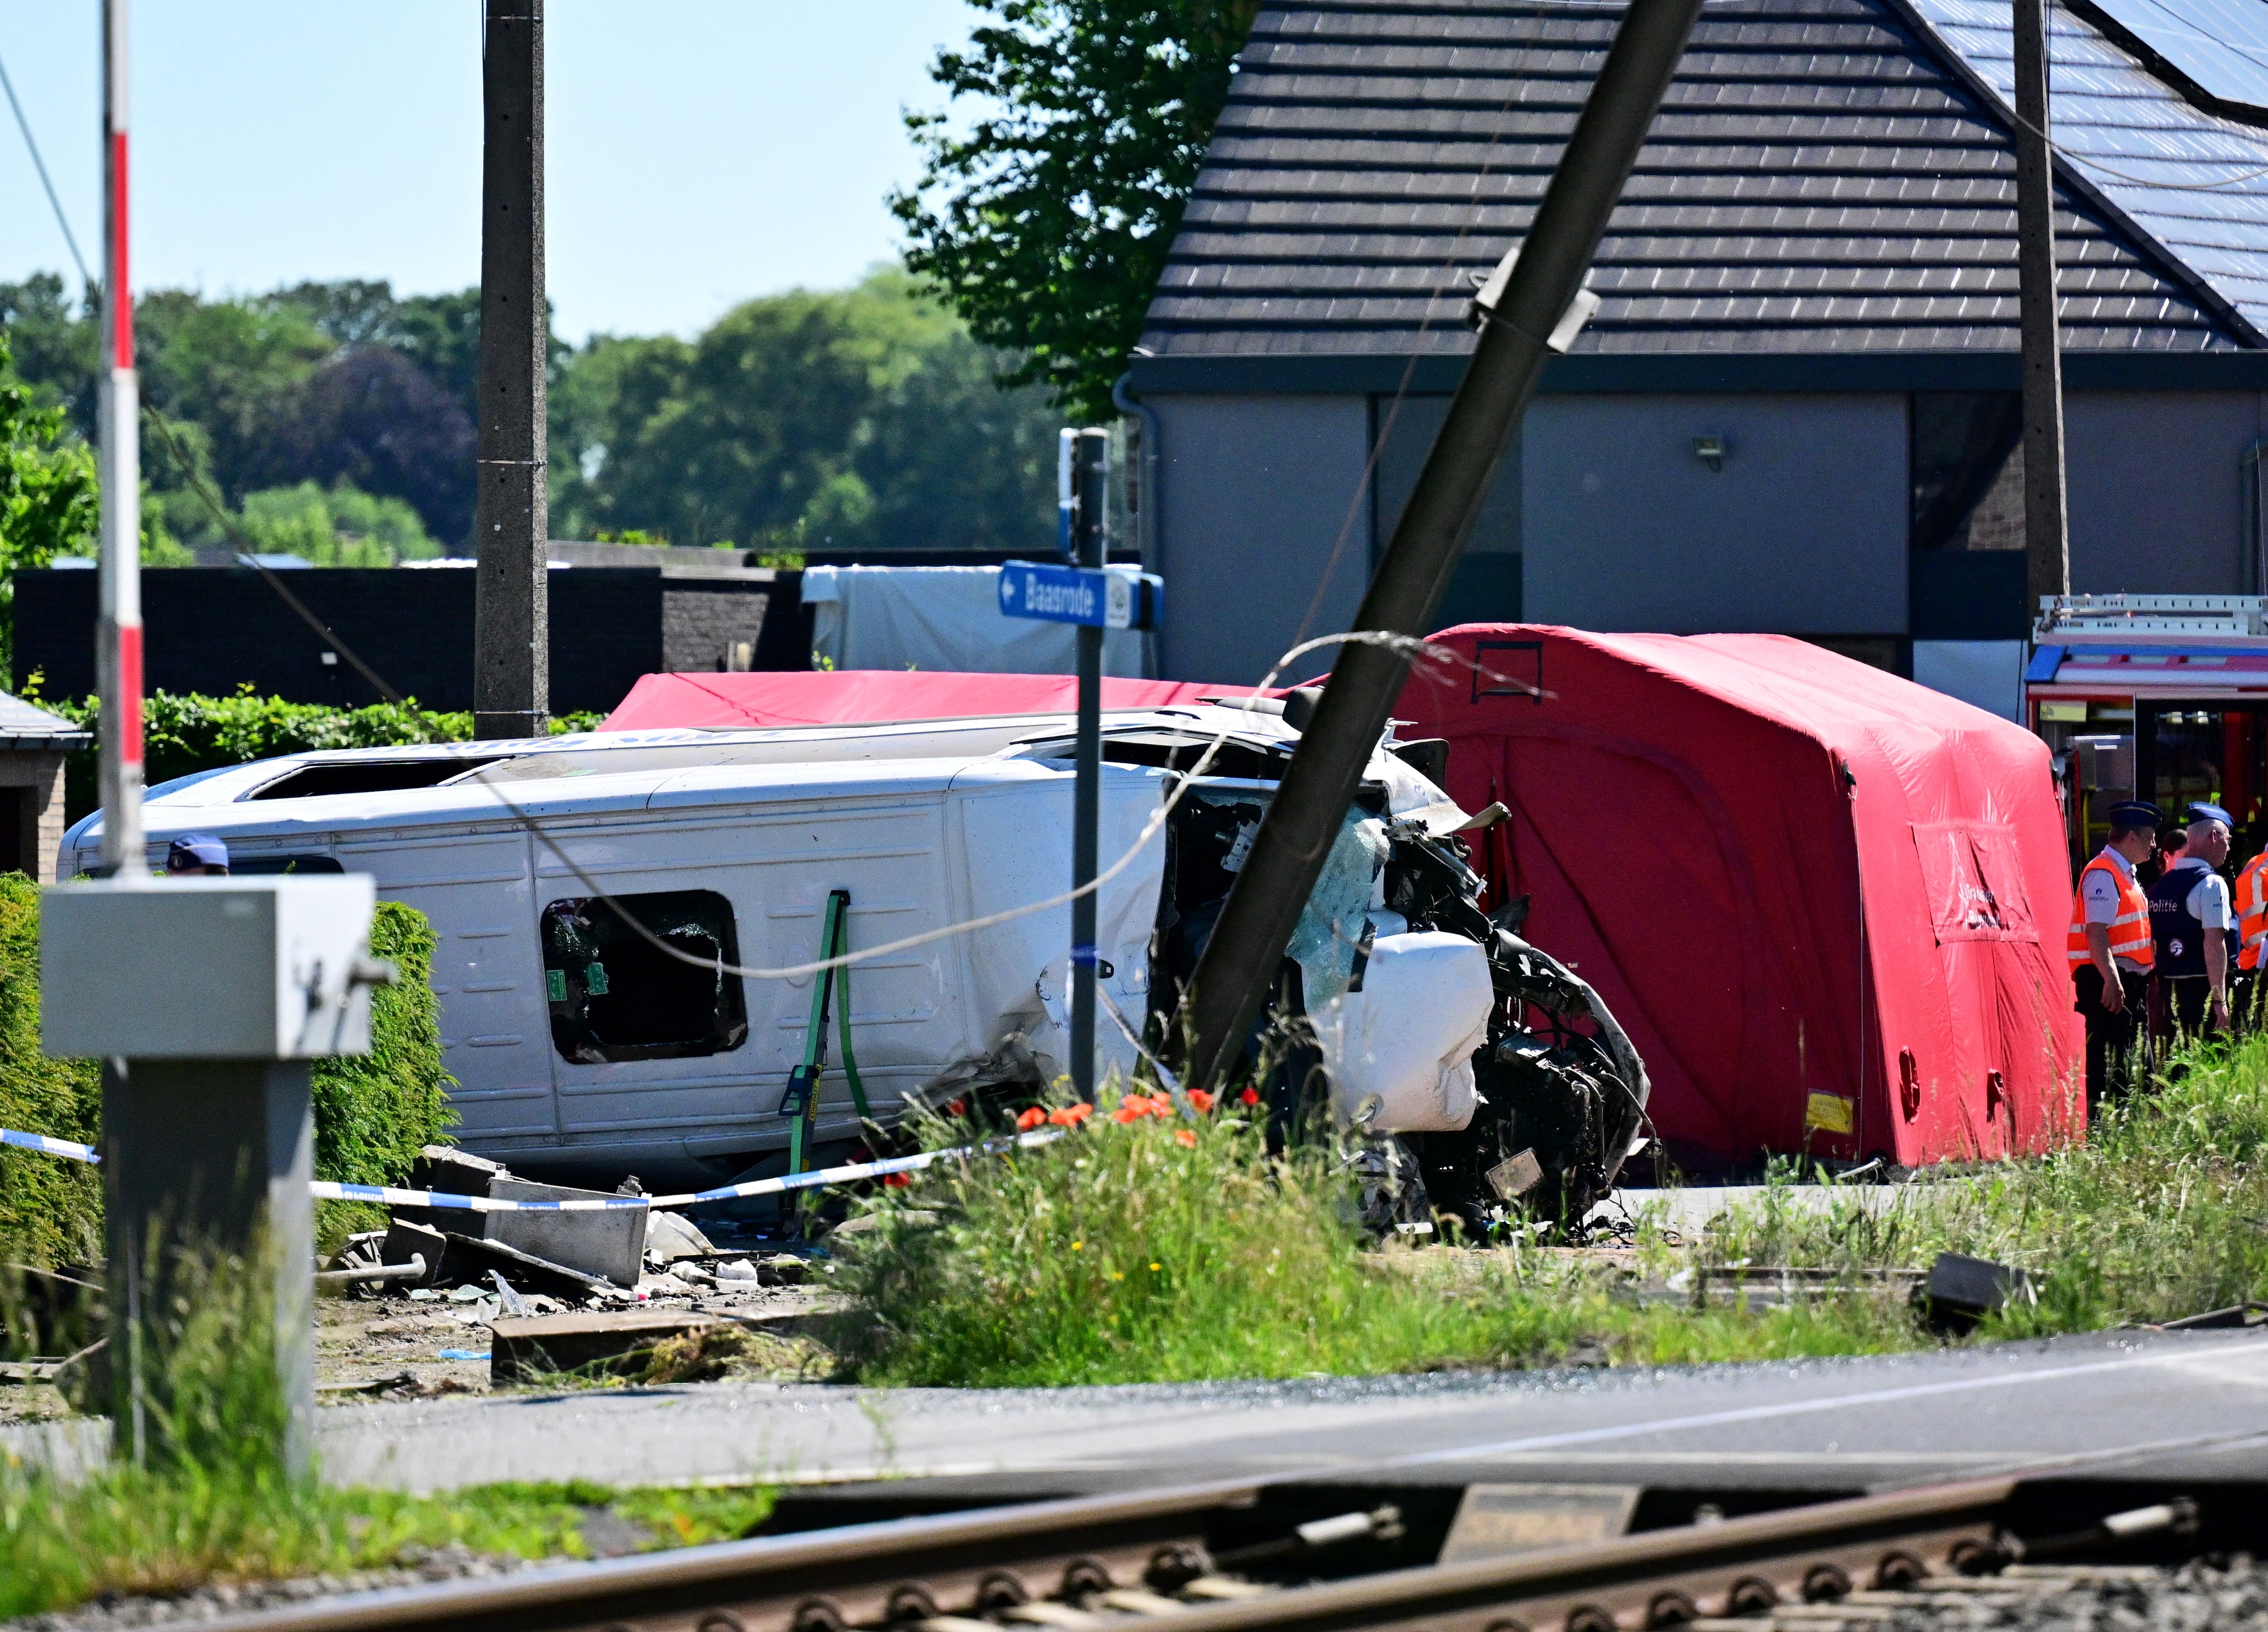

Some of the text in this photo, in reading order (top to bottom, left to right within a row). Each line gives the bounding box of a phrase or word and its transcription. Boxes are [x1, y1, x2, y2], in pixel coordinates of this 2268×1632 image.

[1025, 572, 1094, 618] Baasrode
[2149, 899, 2177, 912] Politie
[810, 1084, 818, 1119] STABFAST
